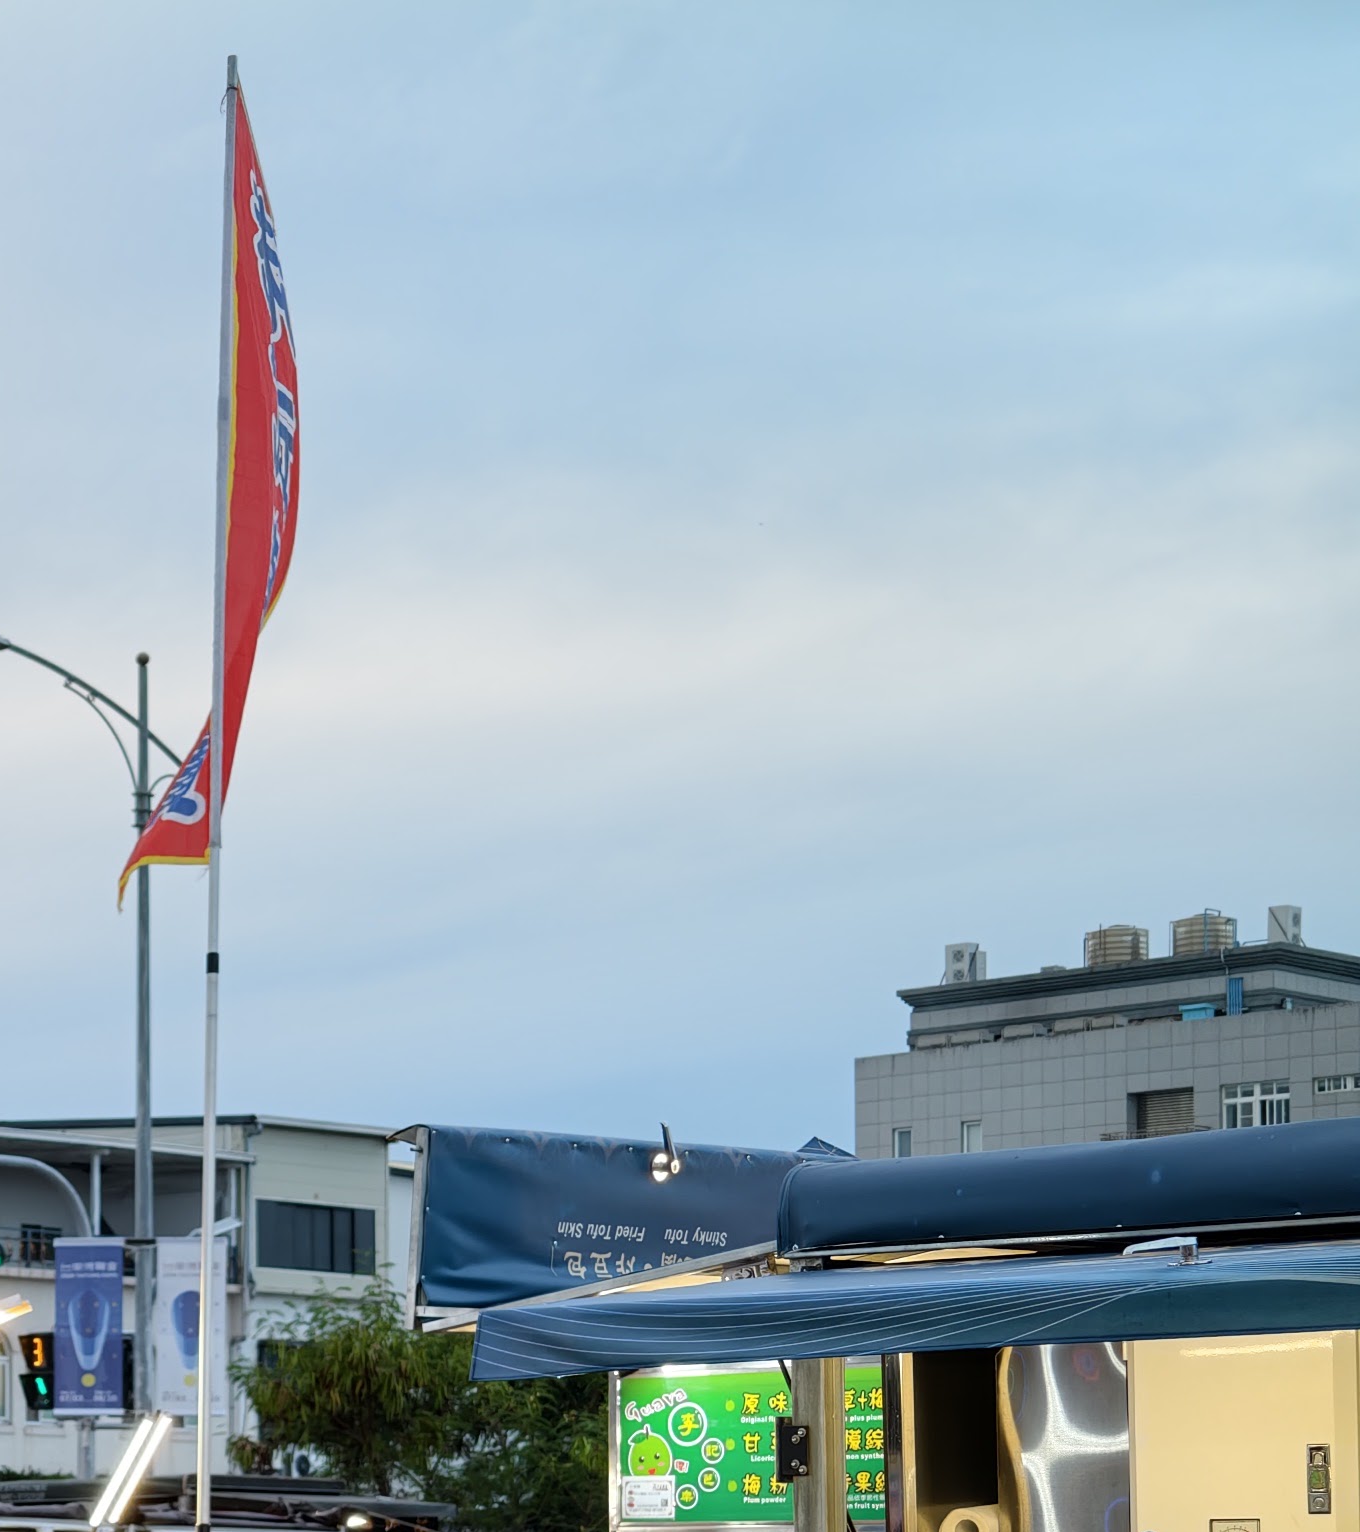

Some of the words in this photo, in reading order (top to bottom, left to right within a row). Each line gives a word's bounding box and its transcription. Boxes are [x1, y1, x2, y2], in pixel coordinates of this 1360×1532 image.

[557, 1221, 583, 1238] Skin
[586, 1223, 612, 1240] Tofu
[614, 1225, 646, 1242] Fried
[664, 1228, 689, 1245] Tofu
[692, 1226, 728, 1247] Stinky
[625, 1388, 687, 1422] Guava
[741, 1391, 788, 1415] 原味
